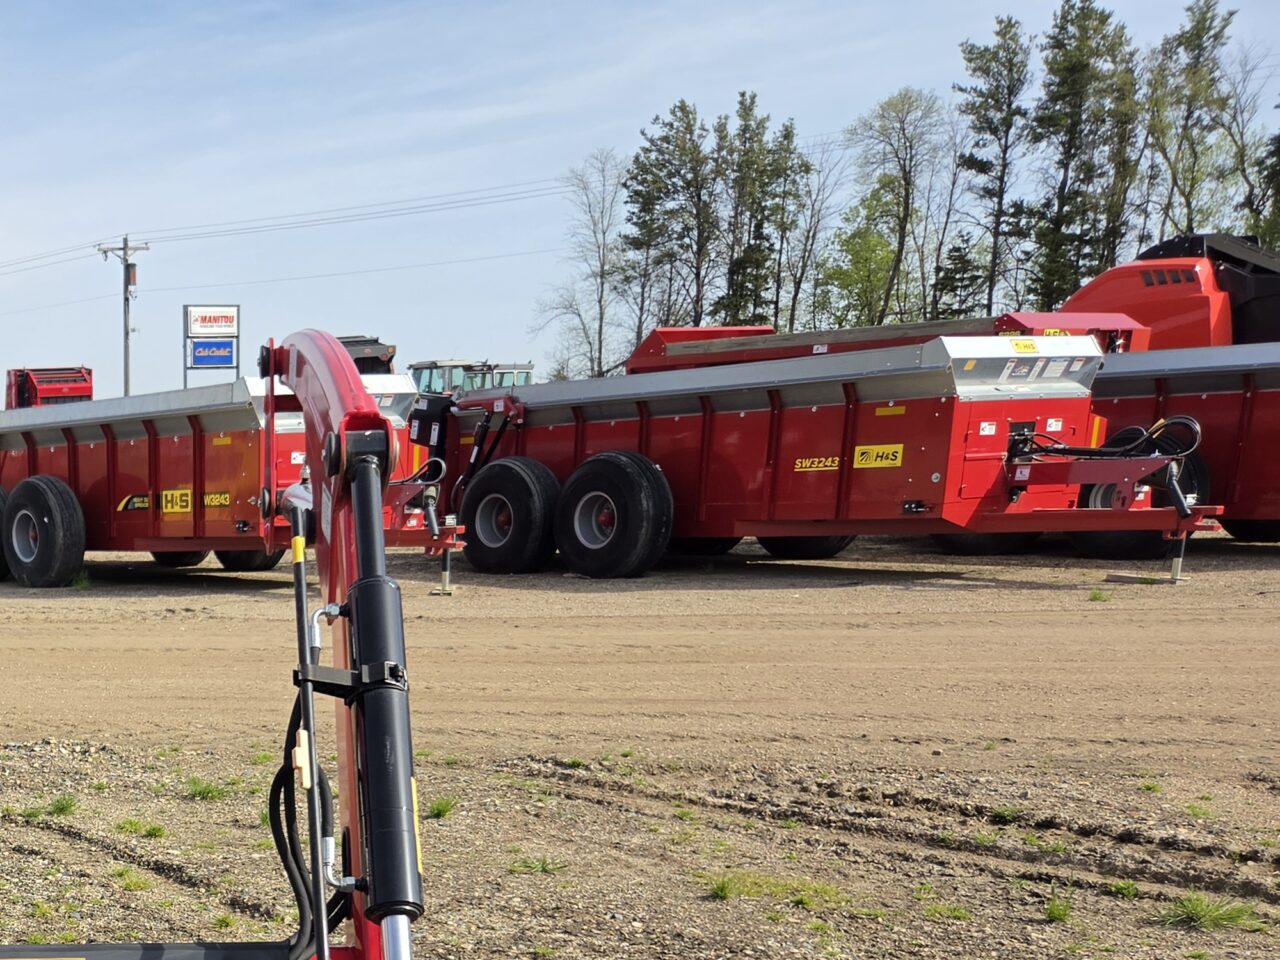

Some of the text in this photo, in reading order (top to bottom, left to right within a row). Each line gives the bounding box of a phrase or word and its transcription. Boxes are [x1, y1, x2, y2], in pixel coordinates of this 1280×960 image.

[200, 315, 234, 324] MANITOU
[874, 451, 899, 462] H&S
[794, 457, 839, 470] SW3243
[164, 493, 189, 510] H&S
